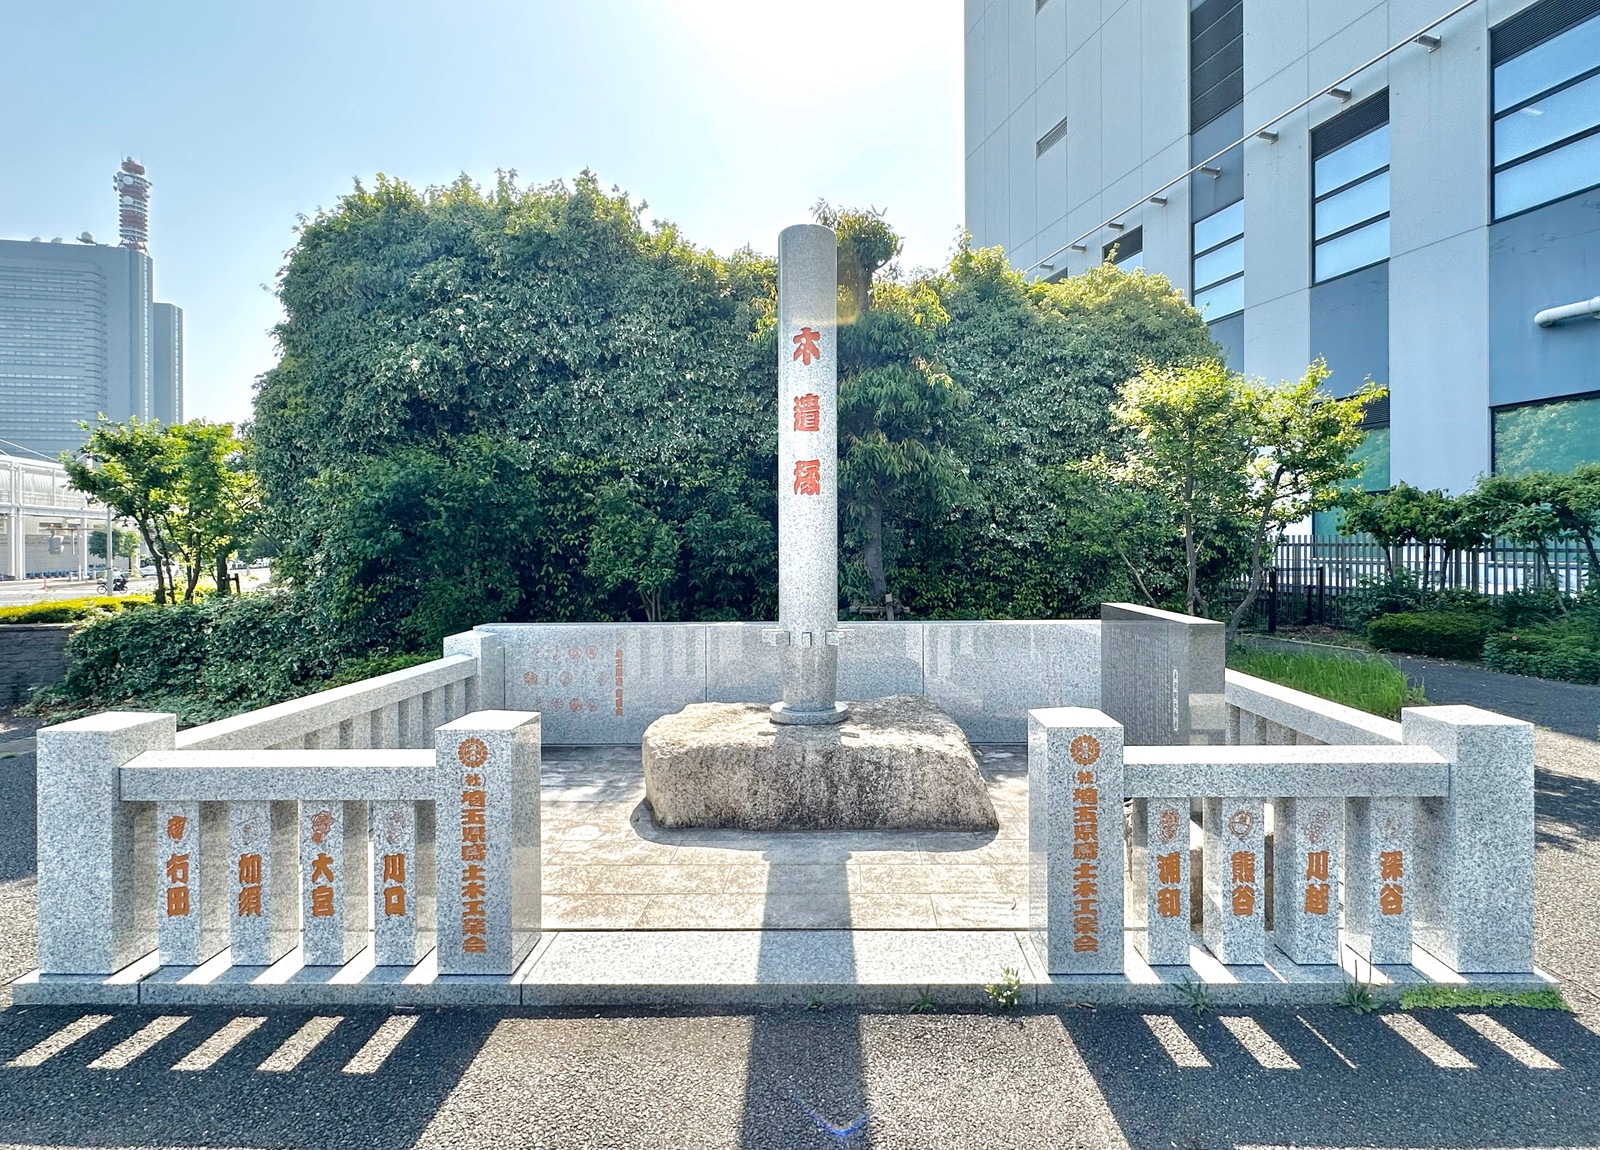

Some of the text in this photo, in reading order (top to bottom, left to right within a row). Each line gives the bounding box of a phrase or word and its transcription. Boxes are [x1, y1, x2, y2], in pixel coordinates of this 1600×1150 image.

[793, 327, 821, 496] 木遣塚
[166, 853, 190, 917] 行田
[238, 853, 263, 917] 加須
[311, 853, 335, 917] 大宮
[384, 853, 406, 916] 川口
[1157, 851, 1181, 917] 浦和
[1231, 851, 1256, 916] 熊谷
[1304, 851, 1330, 915] 川越
[1379, 851, 1404, 916] 深谷
